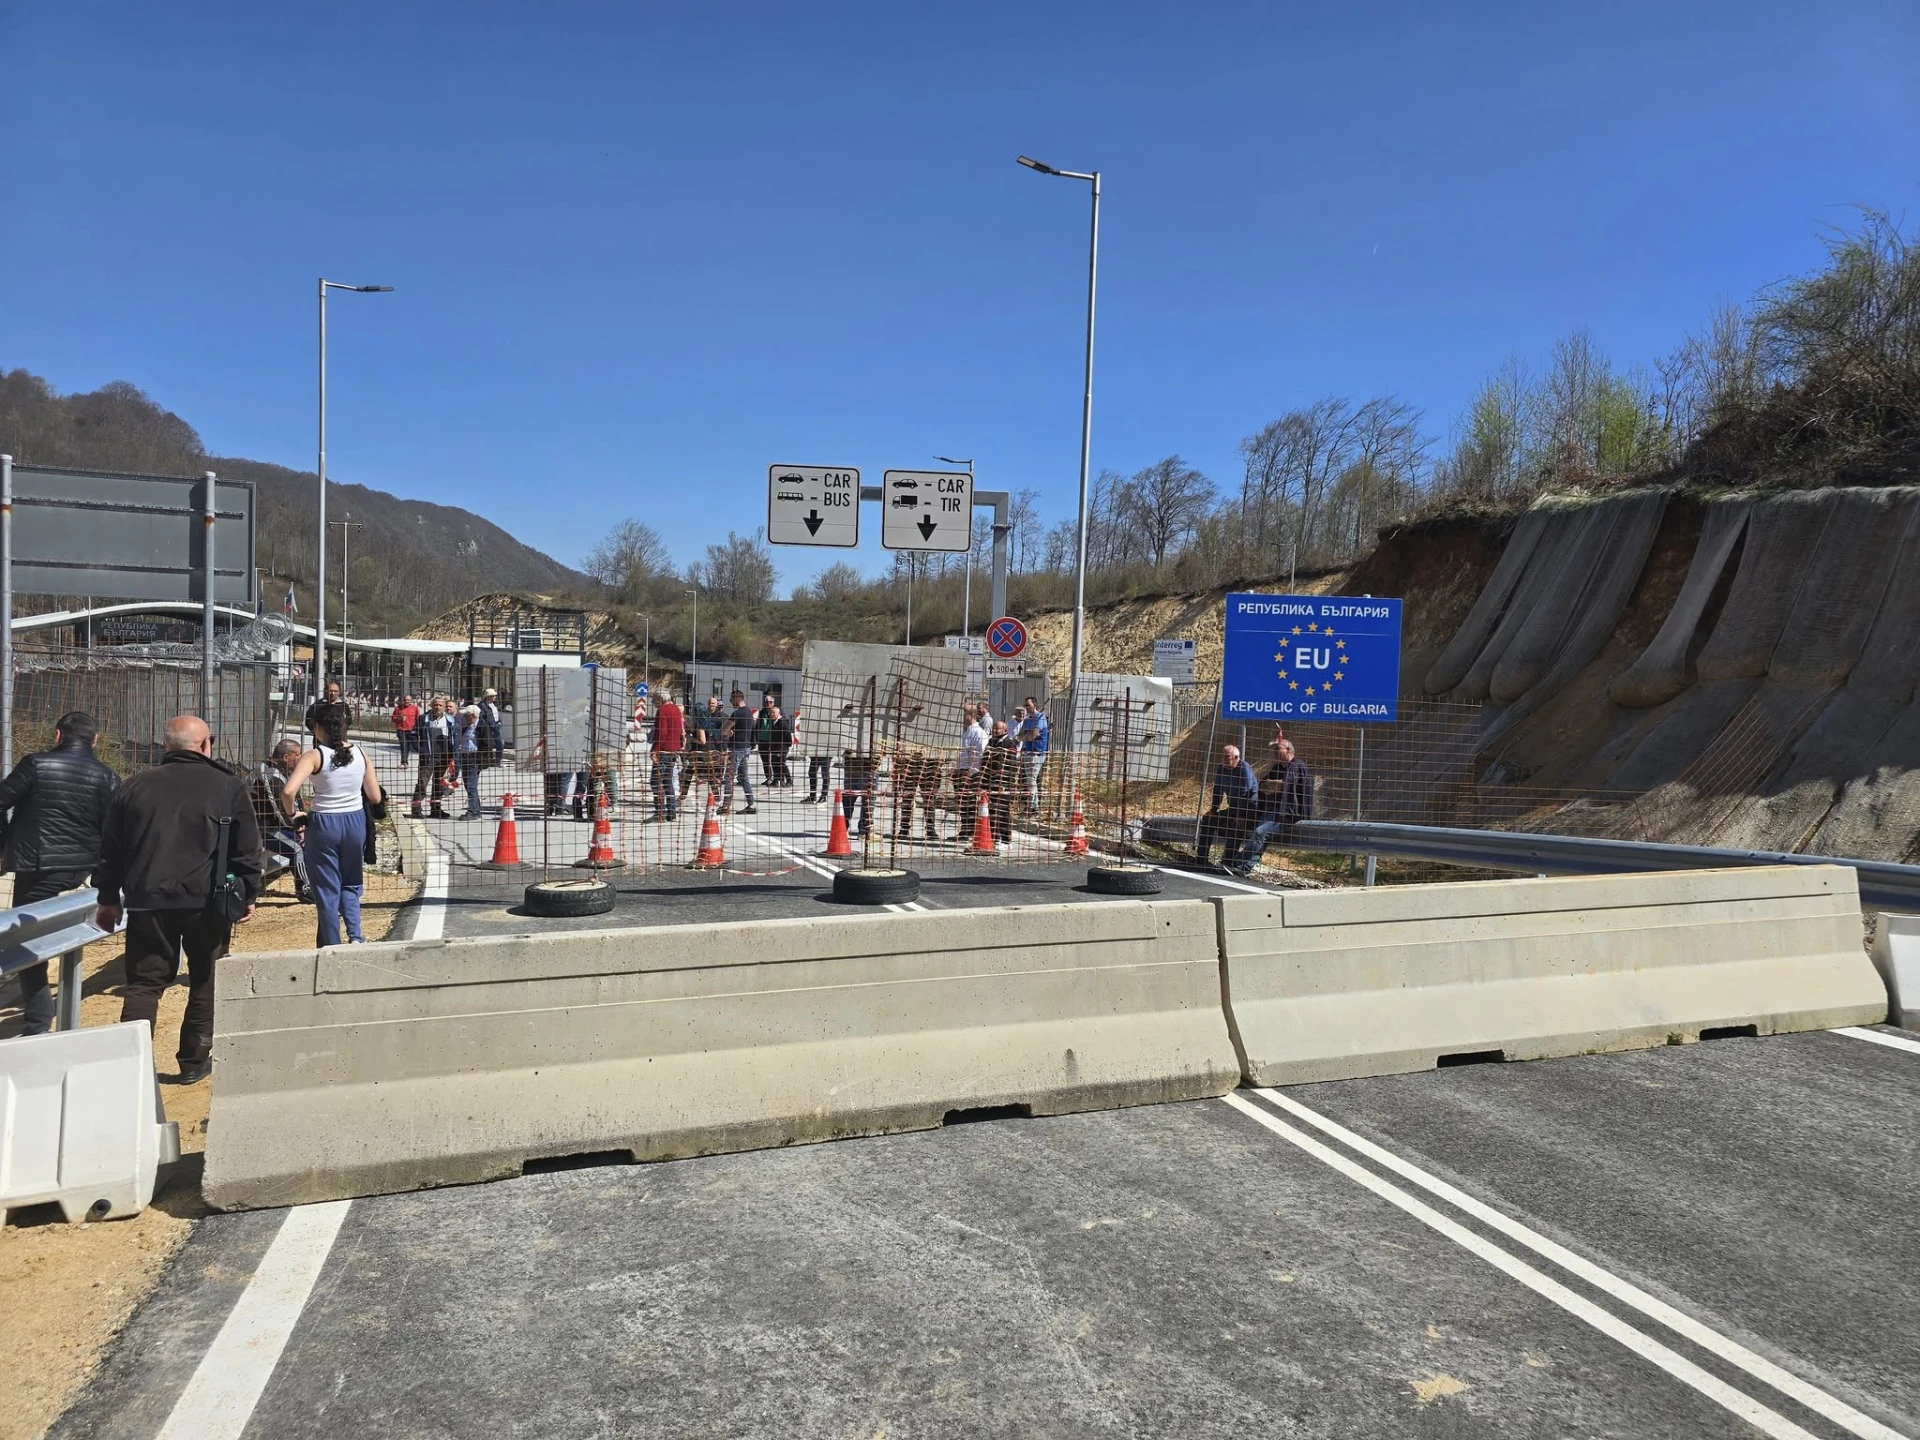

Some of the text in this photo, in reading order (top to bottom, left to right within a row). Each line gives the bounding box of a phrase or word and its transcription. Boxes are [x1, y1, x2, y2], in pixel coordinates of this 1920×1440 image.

[824, 473, 851, 488] CAR
[938, 478, 964, 494] CAR
[824, 491, 850, 507] BUS
[941, 498, 961, 512] TIR
[1238, 603, 1389, 618] РЕПУБЛИКА БЪЛГАРИЯ
[101, 622, 158, 631] РЕПУБЛИКА
[103, 629, 156, 637] БЪЛГАРИЯ
[1155, 641, 1183, 650] Interreg
[1295, 647, 1330, 670] EU
[1229, 701, 1388, 715] REPUBLIC OF BULGARIA
